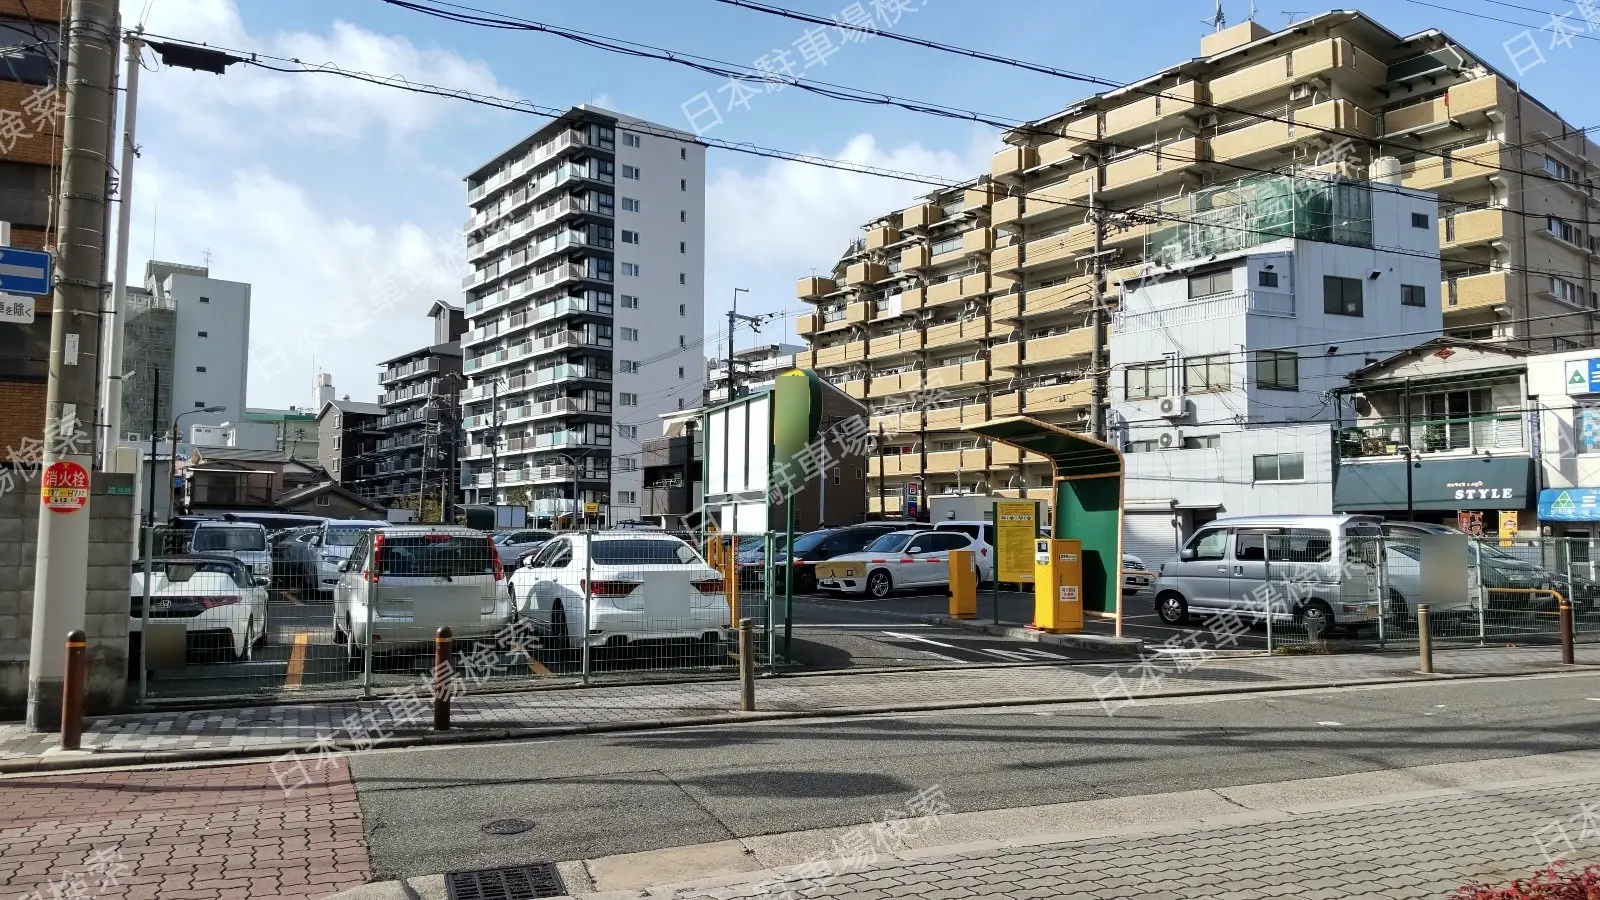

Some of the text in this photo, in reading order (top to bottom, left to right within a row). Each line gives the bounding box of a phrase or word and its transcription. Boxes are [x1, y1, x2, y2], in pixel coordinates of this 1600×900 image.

[46, 470, 85, 487] 消火栓
[1455, 488, 1513, 499] STYLE
[829, 569, 853, 578] 入口
